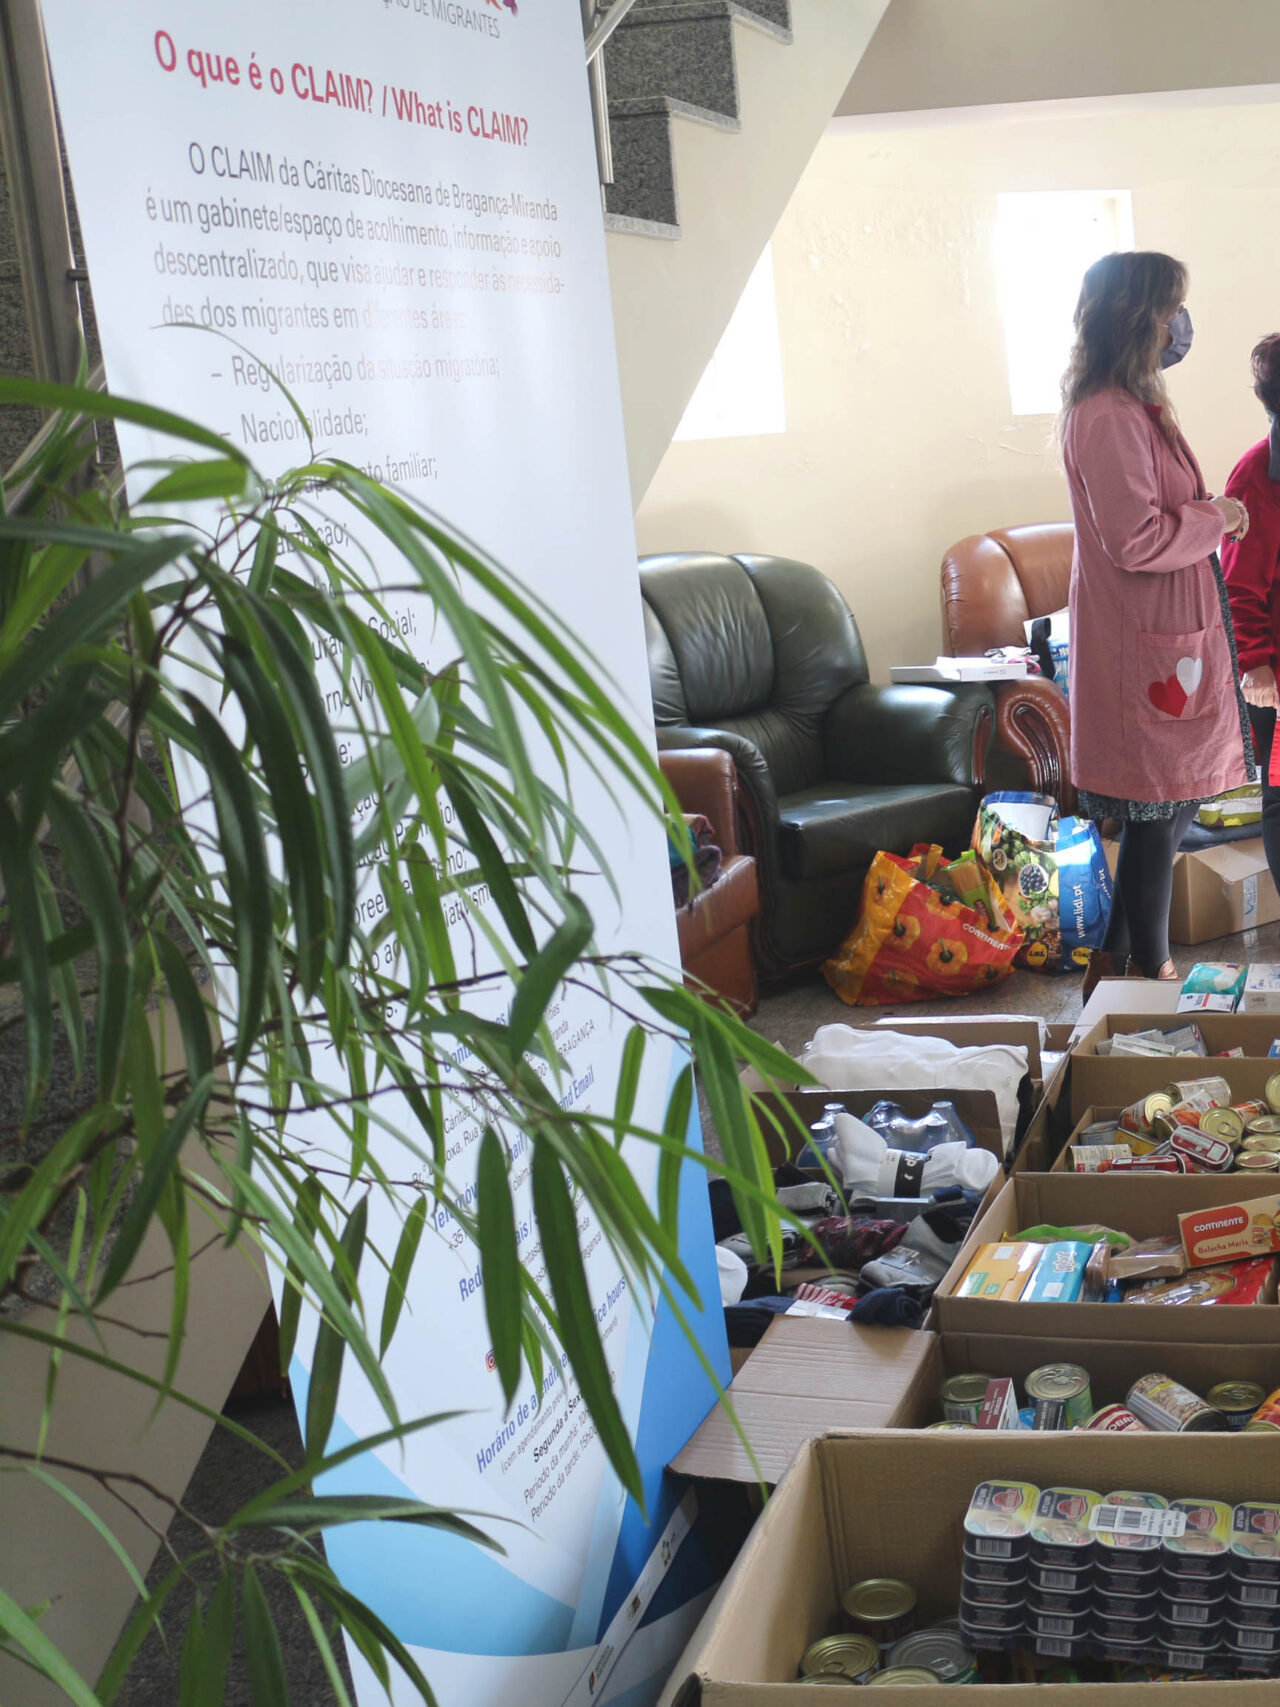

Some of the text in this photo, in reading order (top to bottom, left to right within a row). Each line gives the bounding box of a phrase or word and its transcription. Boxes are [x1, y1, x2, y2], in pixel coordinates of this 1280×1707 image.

[431, 0, 501, 39] MIGRANTES
[154, 30, 177, 72] O
[187, 49, 241, 89] que
[249, 52, 263, 90] é
[270, 68, 284, 95] o
[291, 63, 373, 114] CLAIM?
[391, 86, 445, 130] What
[447, 100, 463, 134] is
[467, 106, 529, 147] CLAIM?
[188, 142, 558, 222] O CLAIM da Cáritas Diocesana de Bragança-Miranda
[145, 186, 561, 262] é um gabinete/espaço de acolhimento, informação e apoio
[154, 241, 304, 285] descentralizado,
[306, 259, 339, 288] que
[340, 255, 371, 285] visa
[374, 258, 414, 291] ajudar
[418, 267, 426, 287] e
[492, 266, 506, 291] às
[162, 295, 195, 326] des
[200, 296, 237, 328] dos
[242, 297, 329, 335] migrantes
[333, 306, 359, 329] em
[232, 354, 353, 393] Regularização
[357, 353, 375, 381] da
[241, 407, 368, 444] Nacionlidade;
[386, 452, 438, 483] familiar;
[1073, 884, 1086, 938] www.lidl.pt
[573, 1065, 595, 1100] Email
[463, 1126, 479, 1147] Rua
[1193, 1216, 1244, 1233] CONTINENTE
[1198, 1239, 1249, 1255] Bolacha Maria
[607, 1276, 627, 1311] hours
[476, 1421, 515, 1474] Horário
[518, 1403, 530, 1427] de
[533, 1418, 564, 1463] Segunda
[523, 1466, 550, 1505] Período
[551, 1453, 559, 1472] da
[530, 1485, 557, 1523] Período
[557, 1473, 565, 1491] da
